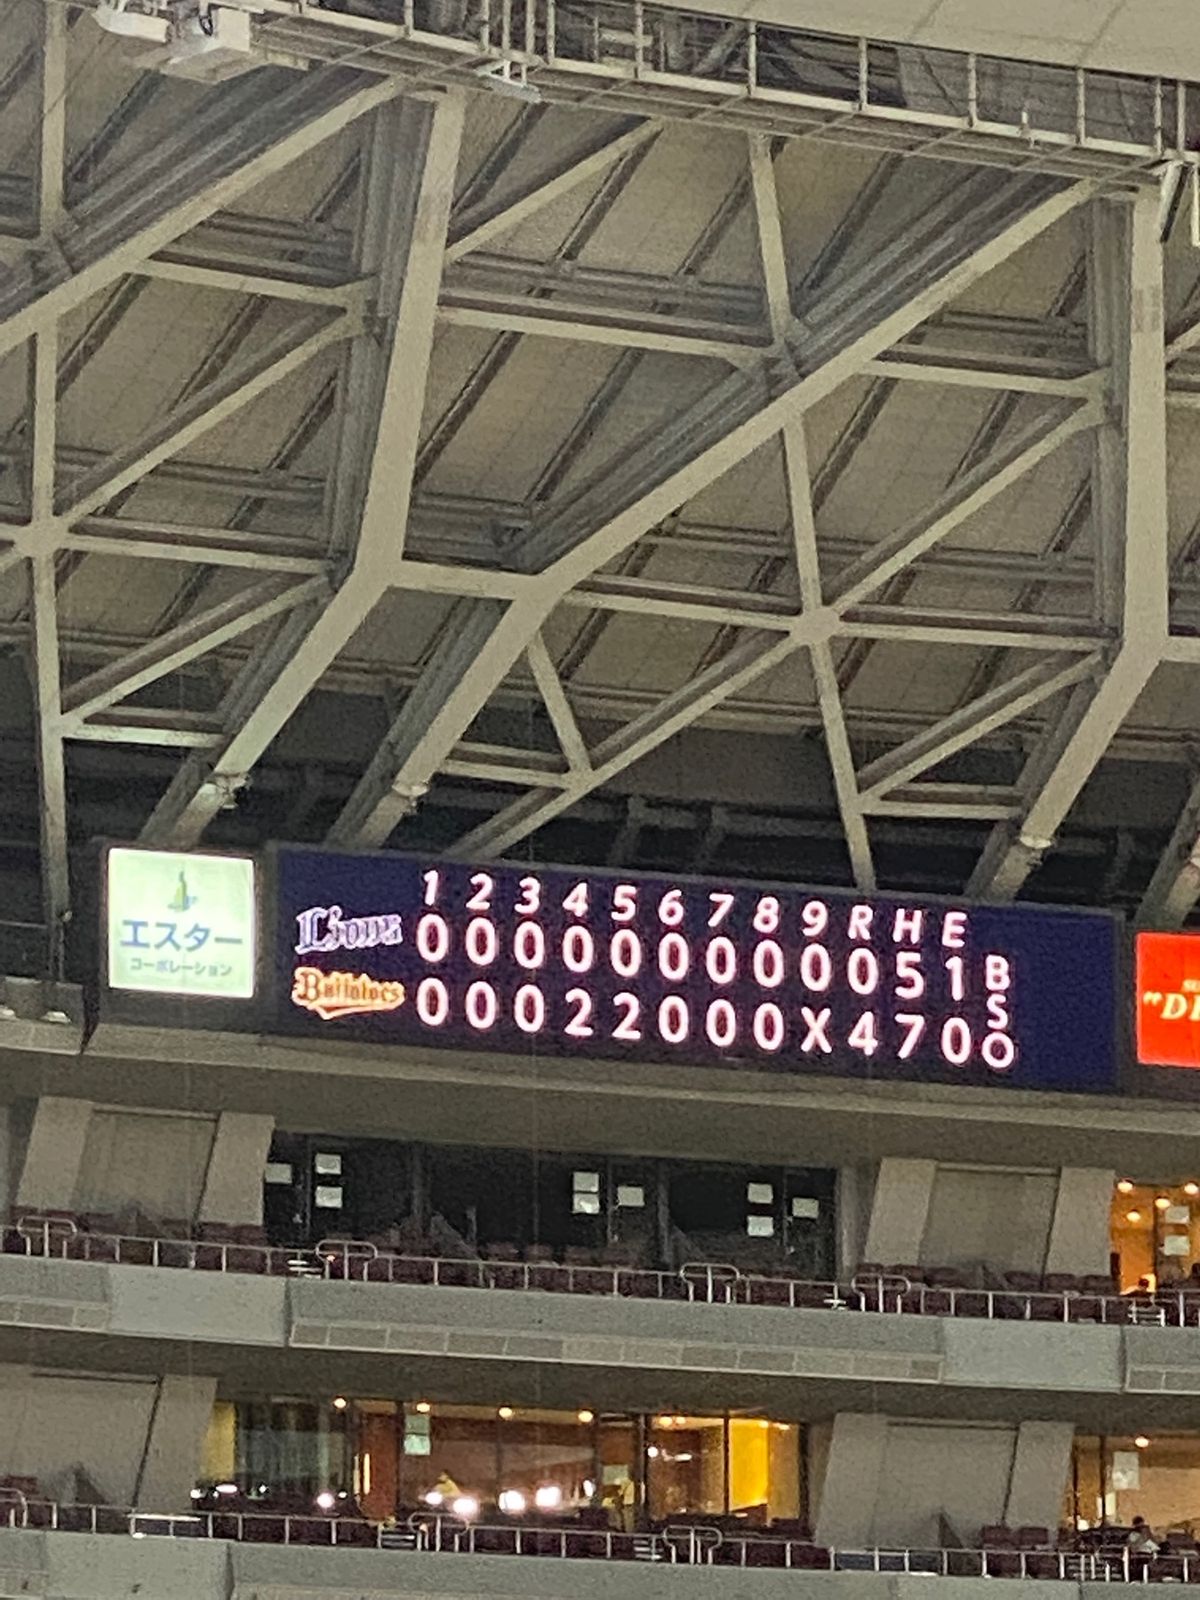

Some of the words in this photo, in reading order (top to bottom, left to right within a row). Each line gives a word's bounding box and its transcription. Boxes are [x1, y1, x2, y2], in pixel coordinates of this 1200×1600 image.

[423, 870, 439, 906] 1
[465, 873, 494, 911] 2
[514, 876, 541, 914] 3
[562, 882, 589, 917] 4
[610, 884, 638, 922] 5
[658, 889, 684, 926] 6
[707, 892, 735, 928] 7
[753, 896, 780, 934] 8
[801, 900, 828, 937] 9
[847, 904, 874, 941] R
[892, 908, 923, 945] H
[941, 911, 967, 949] E
[120, 919, 243, 953] エスター
[130, 957, 233, 978] コーポレーション
[416, 913, 449, 963] 0
[465, 917, 499, 966] 0
[514, 921, 545, 970] 0
[562, 925, 594, 973] 0
[610, 928, 642, 978] 0
[658, 932, 690, 981] 0
[705, 936, 737, 985] 0
[753, 939, 785, 988] 0
[800, 943, 832, 992] 0
[847, 947, 879, 995] 0
[894, 951, 925, 1000] 5
[945, 955, 964, 1002] 1
[985, 954, 1011, 991] B
[416, 977, 449, 1026] 0
[465, 981, 498, 1029] 0
[514, 984, 545, 1033] 0
[564, 987, 594, 1037] 2
[611, 992, 642, 1041] 2
[658, 995, 689, 1044] 0
[706, 998, 737, 1047] 0
[753, 1002, 784, 1051] 0
[800, 1006, 833, 1054] X
[847, 1011, 879, 1058] 4
[894, 1013, 925, 1060] 7
[941, 1017, 972, 1064] 0
[986, 993, 1009, 1030] S
